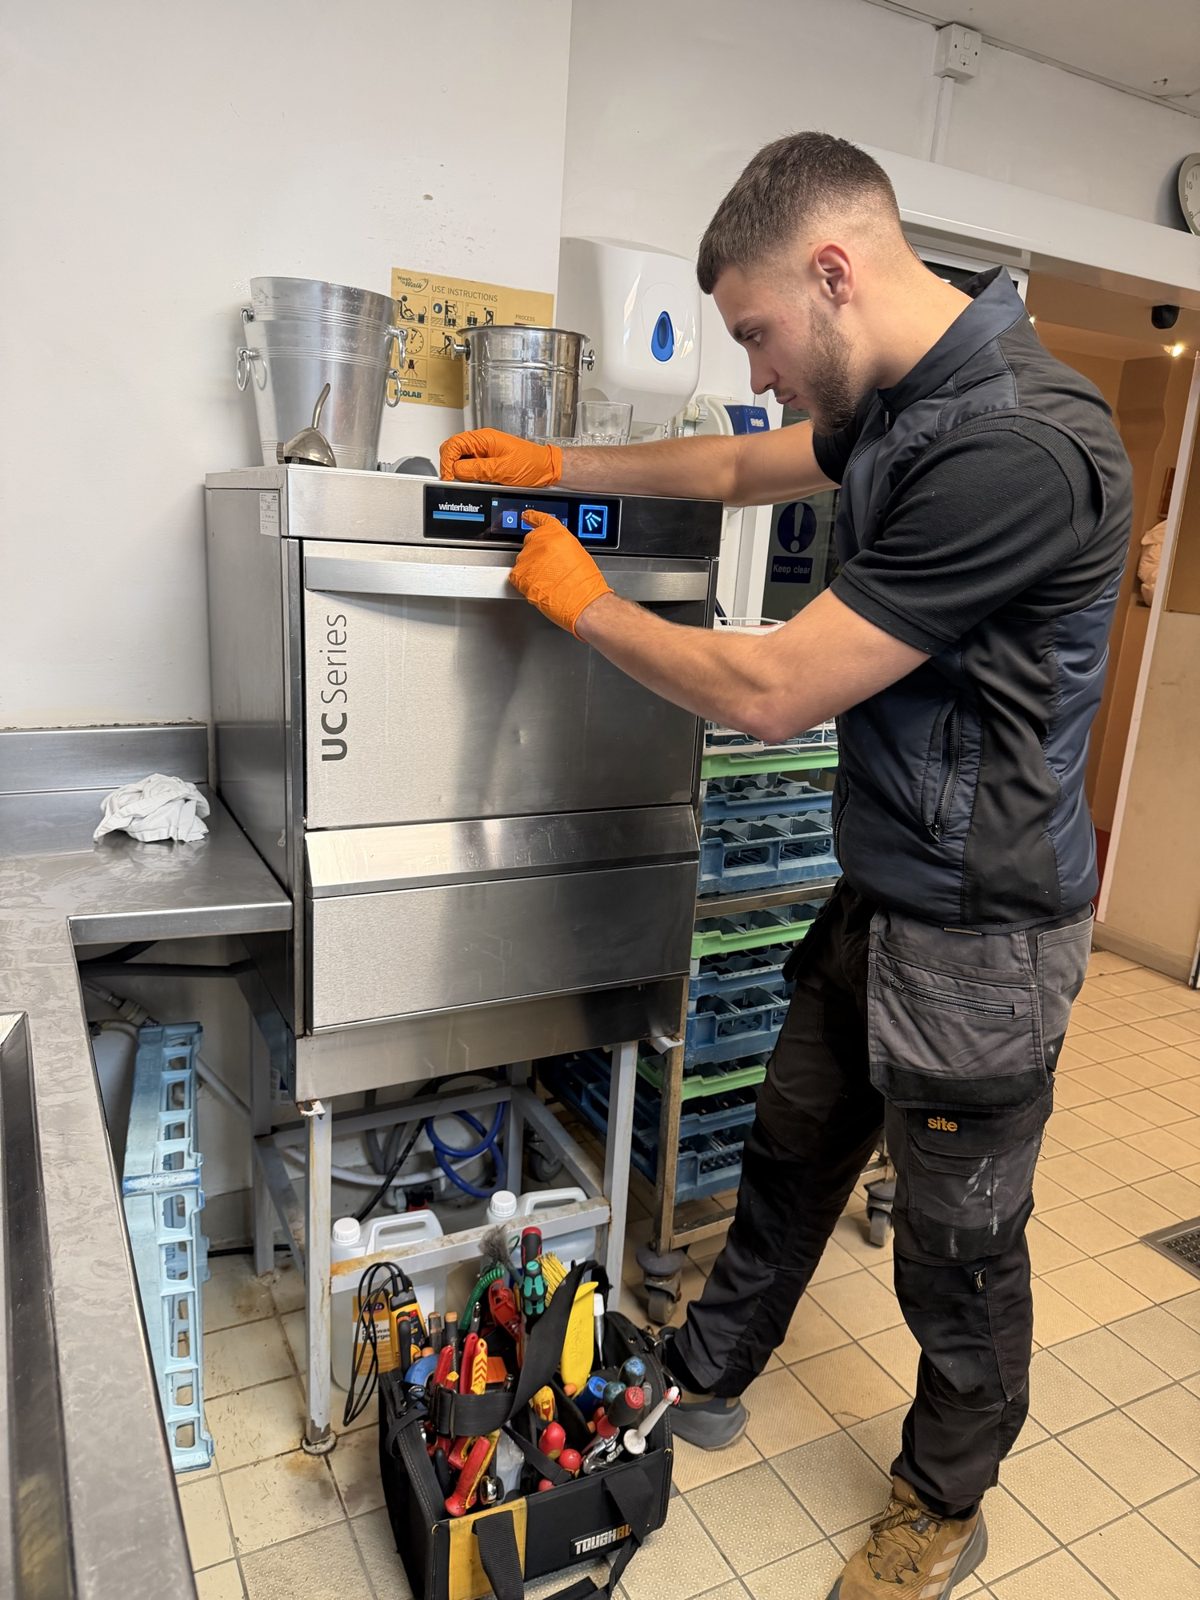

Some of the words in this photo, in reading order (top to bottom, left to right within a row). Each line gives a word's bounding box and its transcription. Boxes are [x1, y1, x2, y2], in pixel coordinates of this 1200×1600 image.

[431, 285, 446, 294] USE
[447, 287, 498, 302] INSTRUCTIONS
[438, 501, 481, 512] winterhalter
[773, 563, 791, 575] Keep
[793, 565, 811, 574] clear
[319, 613, 348, 704] Series
[321, 712, 348, 762] UC
[927, 1116, 958, 1132] site
